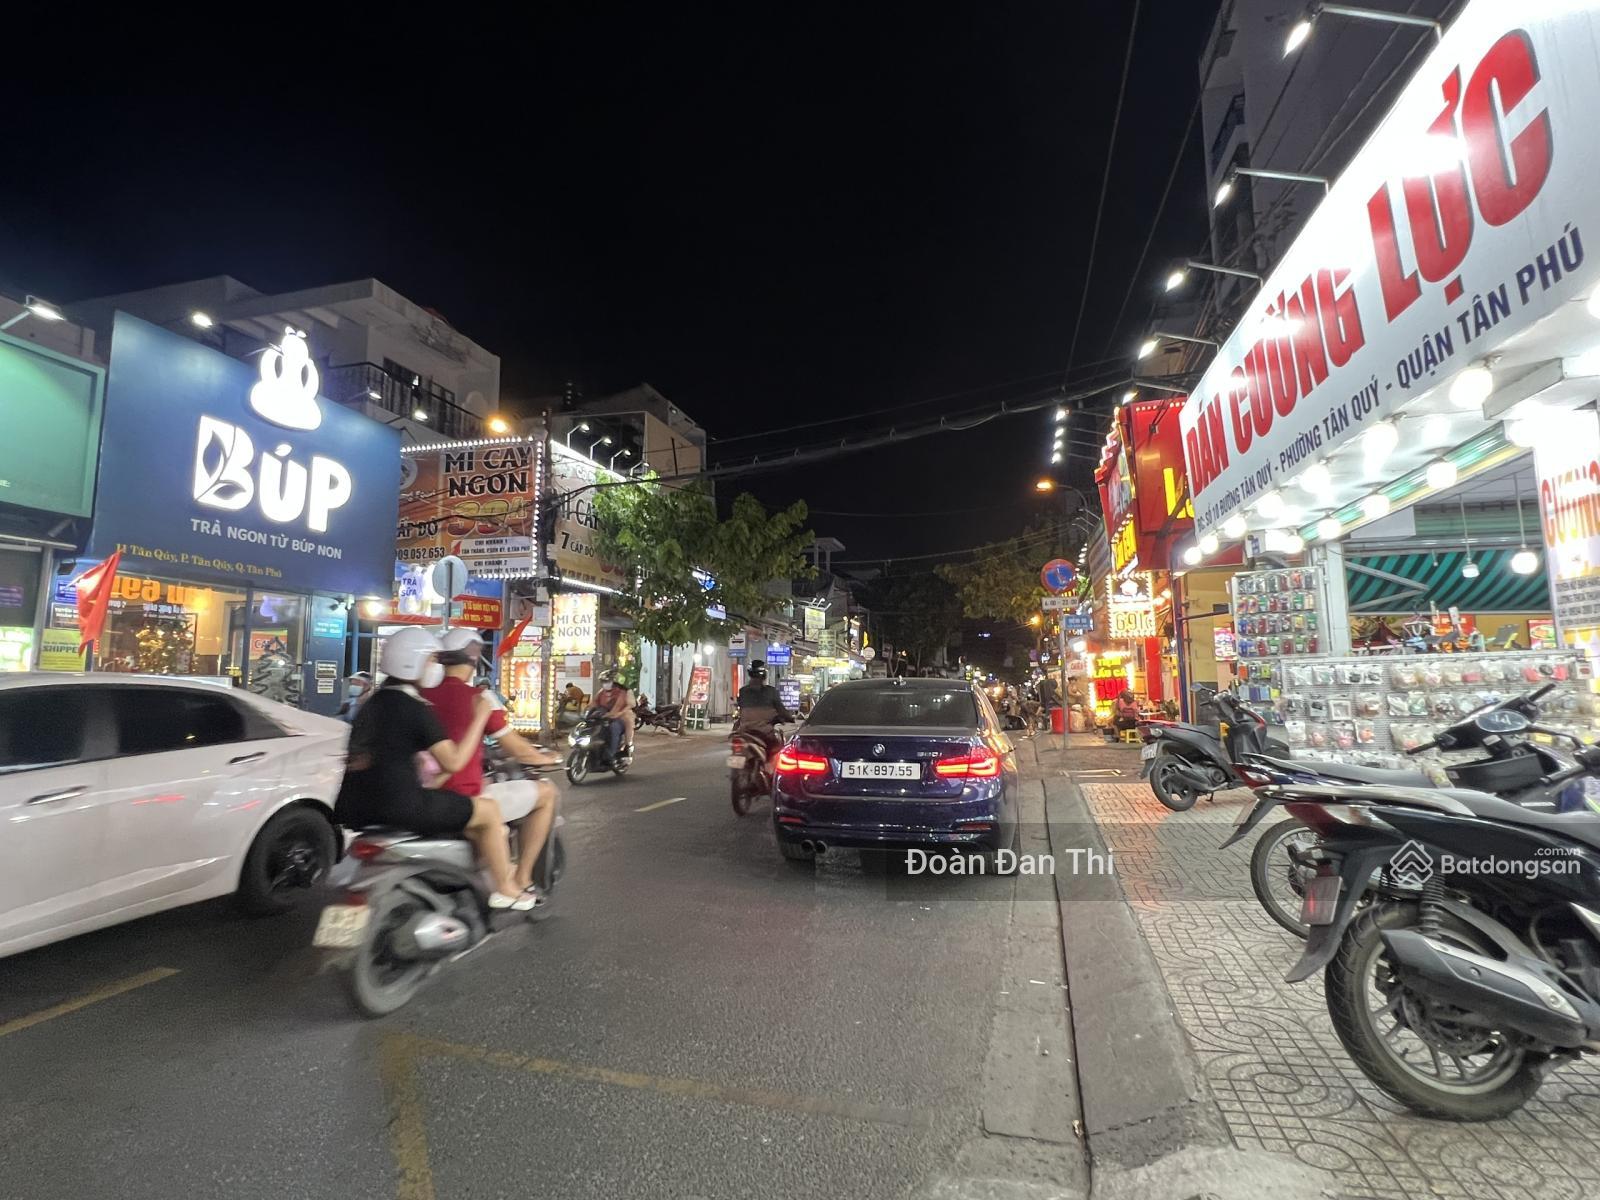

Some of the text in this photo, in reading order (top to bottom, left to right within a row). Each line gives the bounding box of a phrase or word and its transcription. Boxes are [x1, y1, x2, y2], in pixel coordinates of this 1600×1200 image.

[1186, 28, 1554, 498] DÁN CƯỜNG LỰC
[1240, 476, 1256, 500] TÂN
[1279, 424, 1322, 473] PHƯỜNG
[1322, 407, 1350, 440] TÂN
[1351, 374, 1380, 421] QUÝ
[1396, 325, 1455, 389] QUẬN
[1456, 283, 1512, 345] TÂN
[1515, 221, 1585, 306] PHÚ
[482, 446, 532, 469] CAY
[193, 415, 352, 533] BÚP
[448, 472, 527, 497] NGON
[190, 518, 342, 560] TRÀ NGON TỪ BÚP NON
[561, 531, 570, 549] 7
[403, 577, 417, 586] TRÀ
[573, 613, 593, 624] CAY
[558, 626, 591, 637] NGON
[43, 645, 80, 654] SHIPPE
